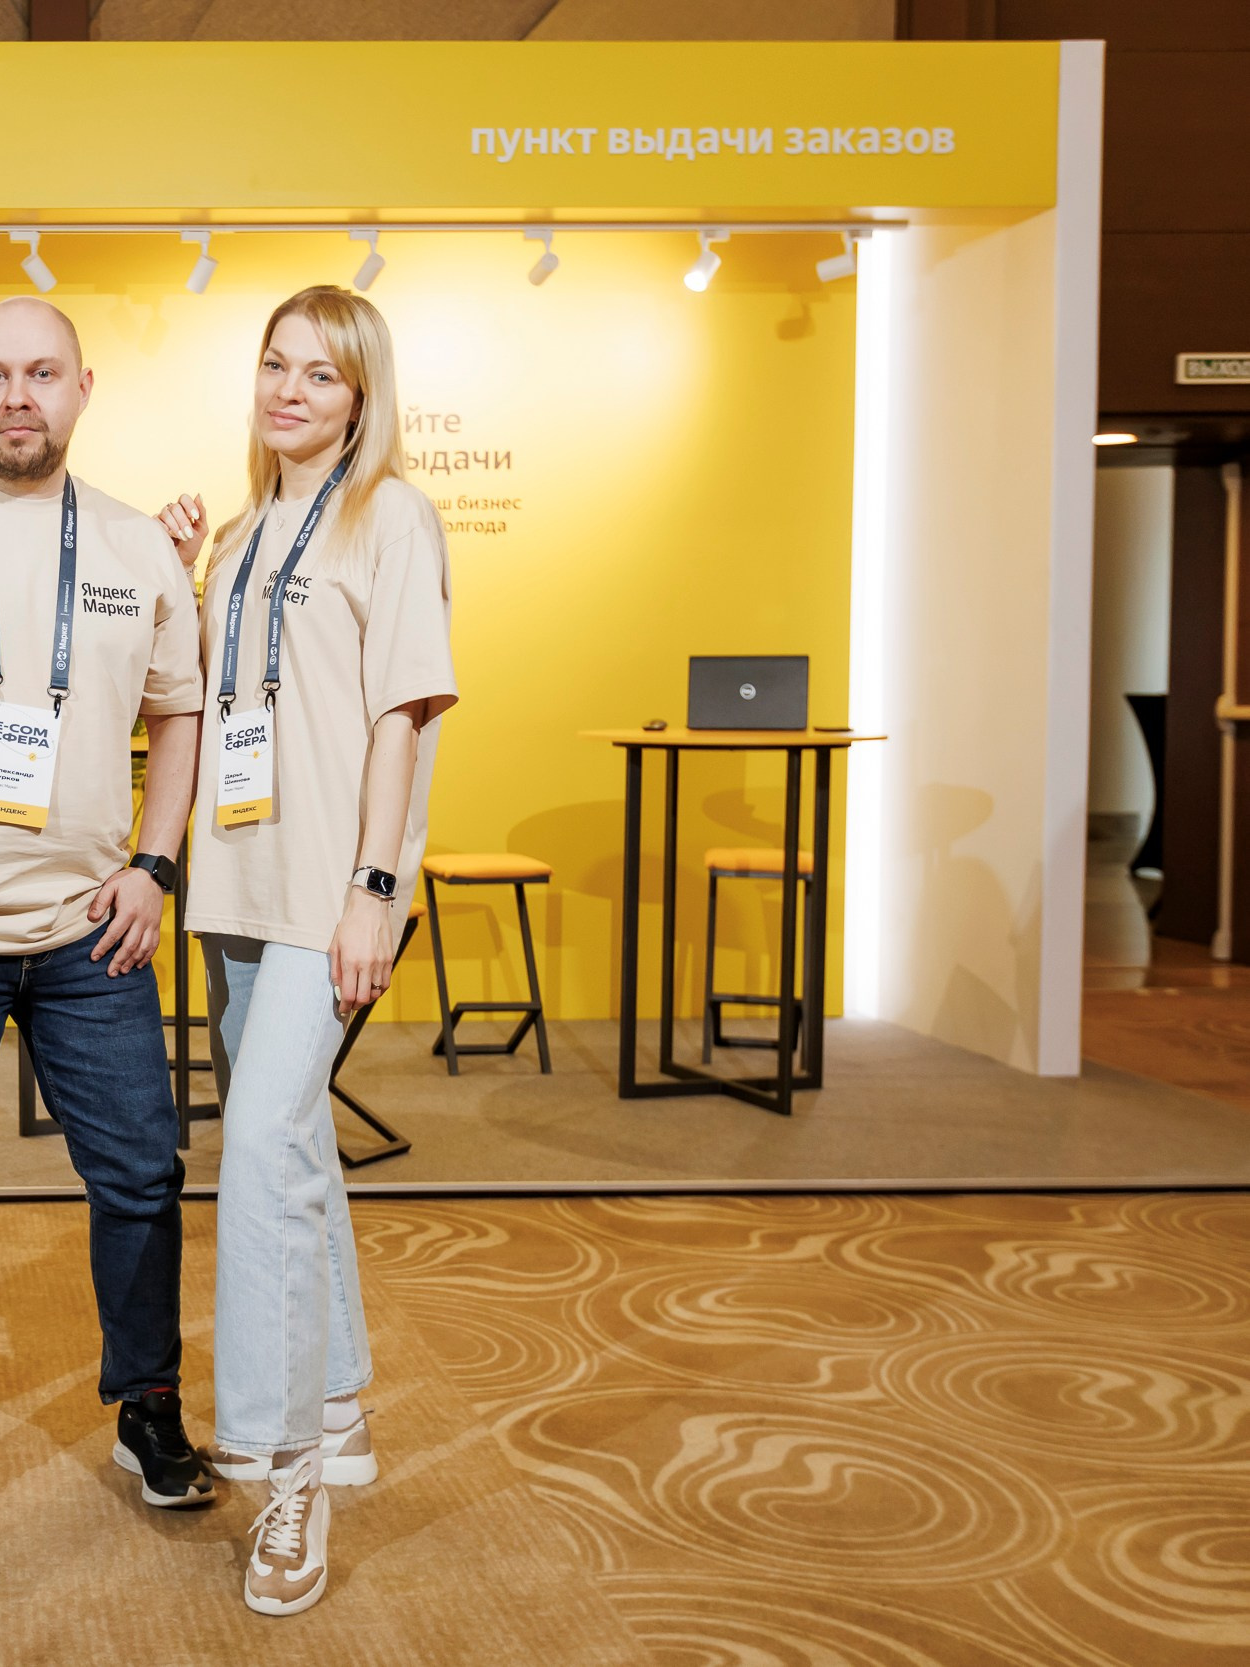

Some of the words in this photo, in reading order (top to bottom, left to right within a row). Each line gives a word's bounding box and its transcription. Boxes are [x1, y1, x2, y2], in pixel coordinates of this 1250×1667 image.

[470, 126, 597, 163] пункт
[607, 126, 774, 161] выдачи
[783, 126, 956, 155] заказов
[405, 406, 461, 433] йте
[406, 451, 511, 475] ыдачи
[457, 495, 522, 510] бизнес
[444, 521, 507, 535] олгода
[266, 570, 312, 589] Яекс
[81, 583, 137, 600] Яндекс
[83, 599, 140, 617] Маркет
[229, 611, 238, 638] Маркет
[59, 622, 68, 650] Маркет
[225, 725, 265, 742] E-COM
[225, 735, 267, 751] СФЕРА
[232, 806, 257, 815] ЯНДЕКС
